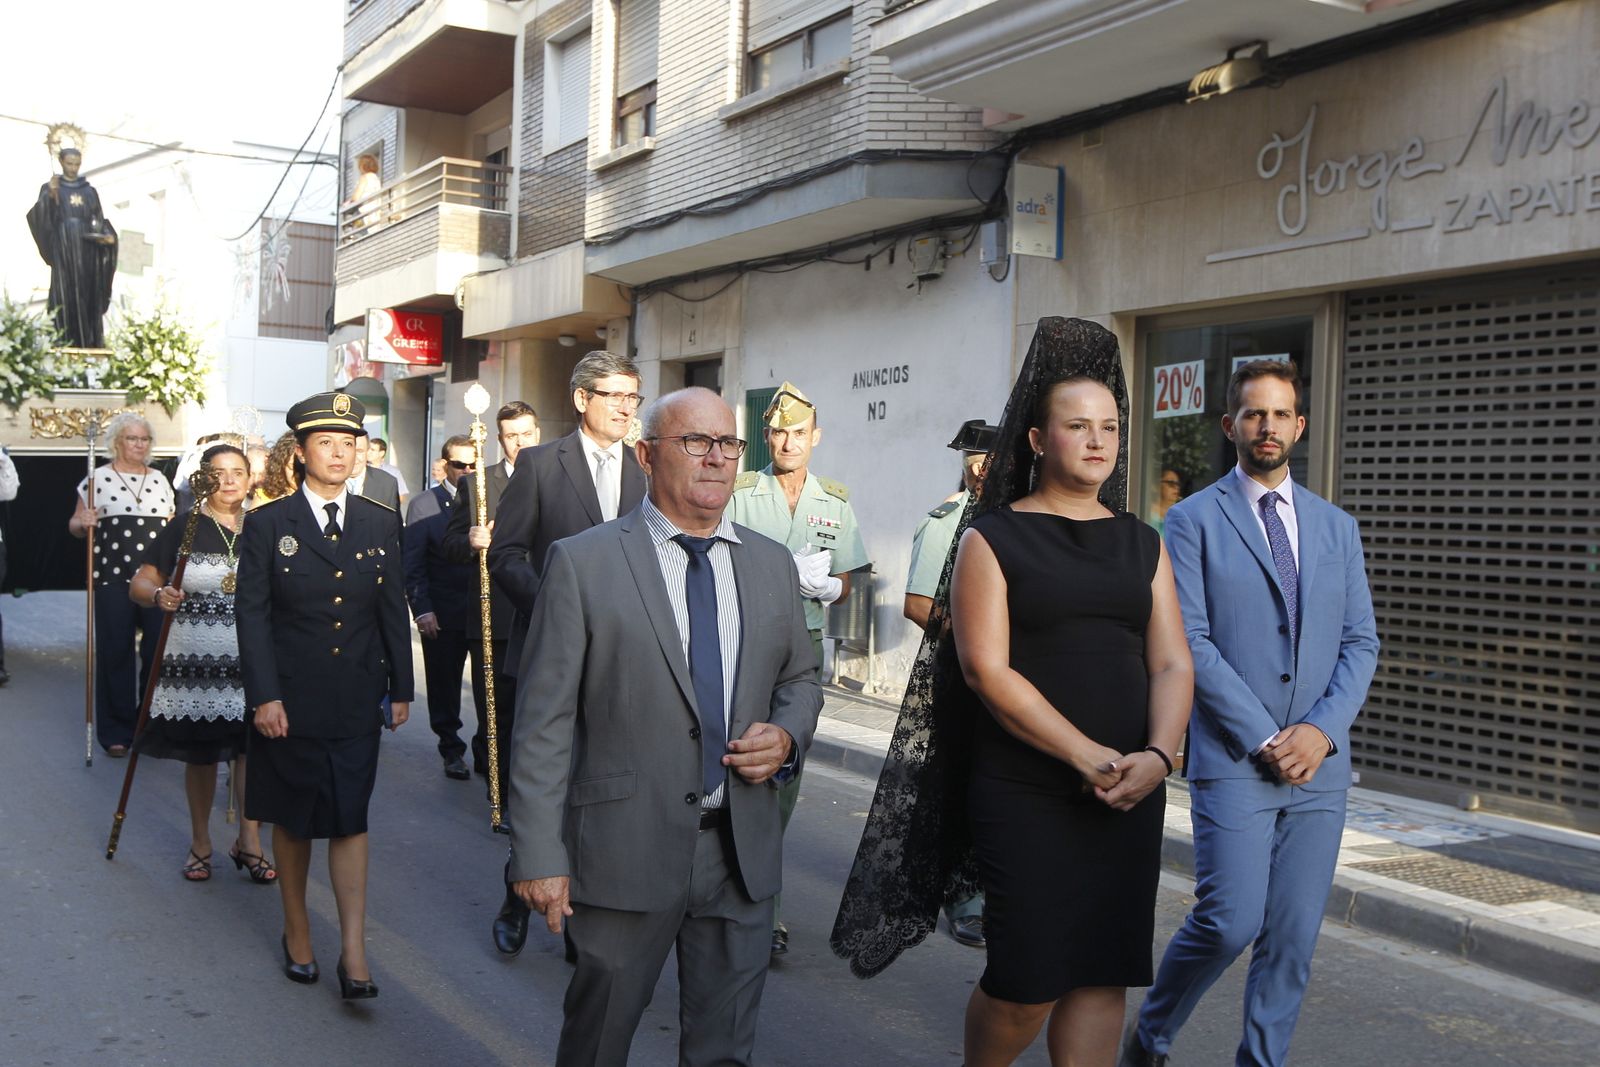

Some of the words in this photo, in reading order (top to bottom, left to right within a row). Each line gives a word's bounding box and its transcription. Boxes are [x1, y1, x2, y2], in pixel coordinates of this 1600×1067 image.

[1256, 102, 1445, 236] Jorge
[1016, 198, 1047, 216] adra
[852, 365, 909, 389] ANUNCIOS
[1156, 363, 1202, 412] 20%
[868, 400, 886, 421] NO
